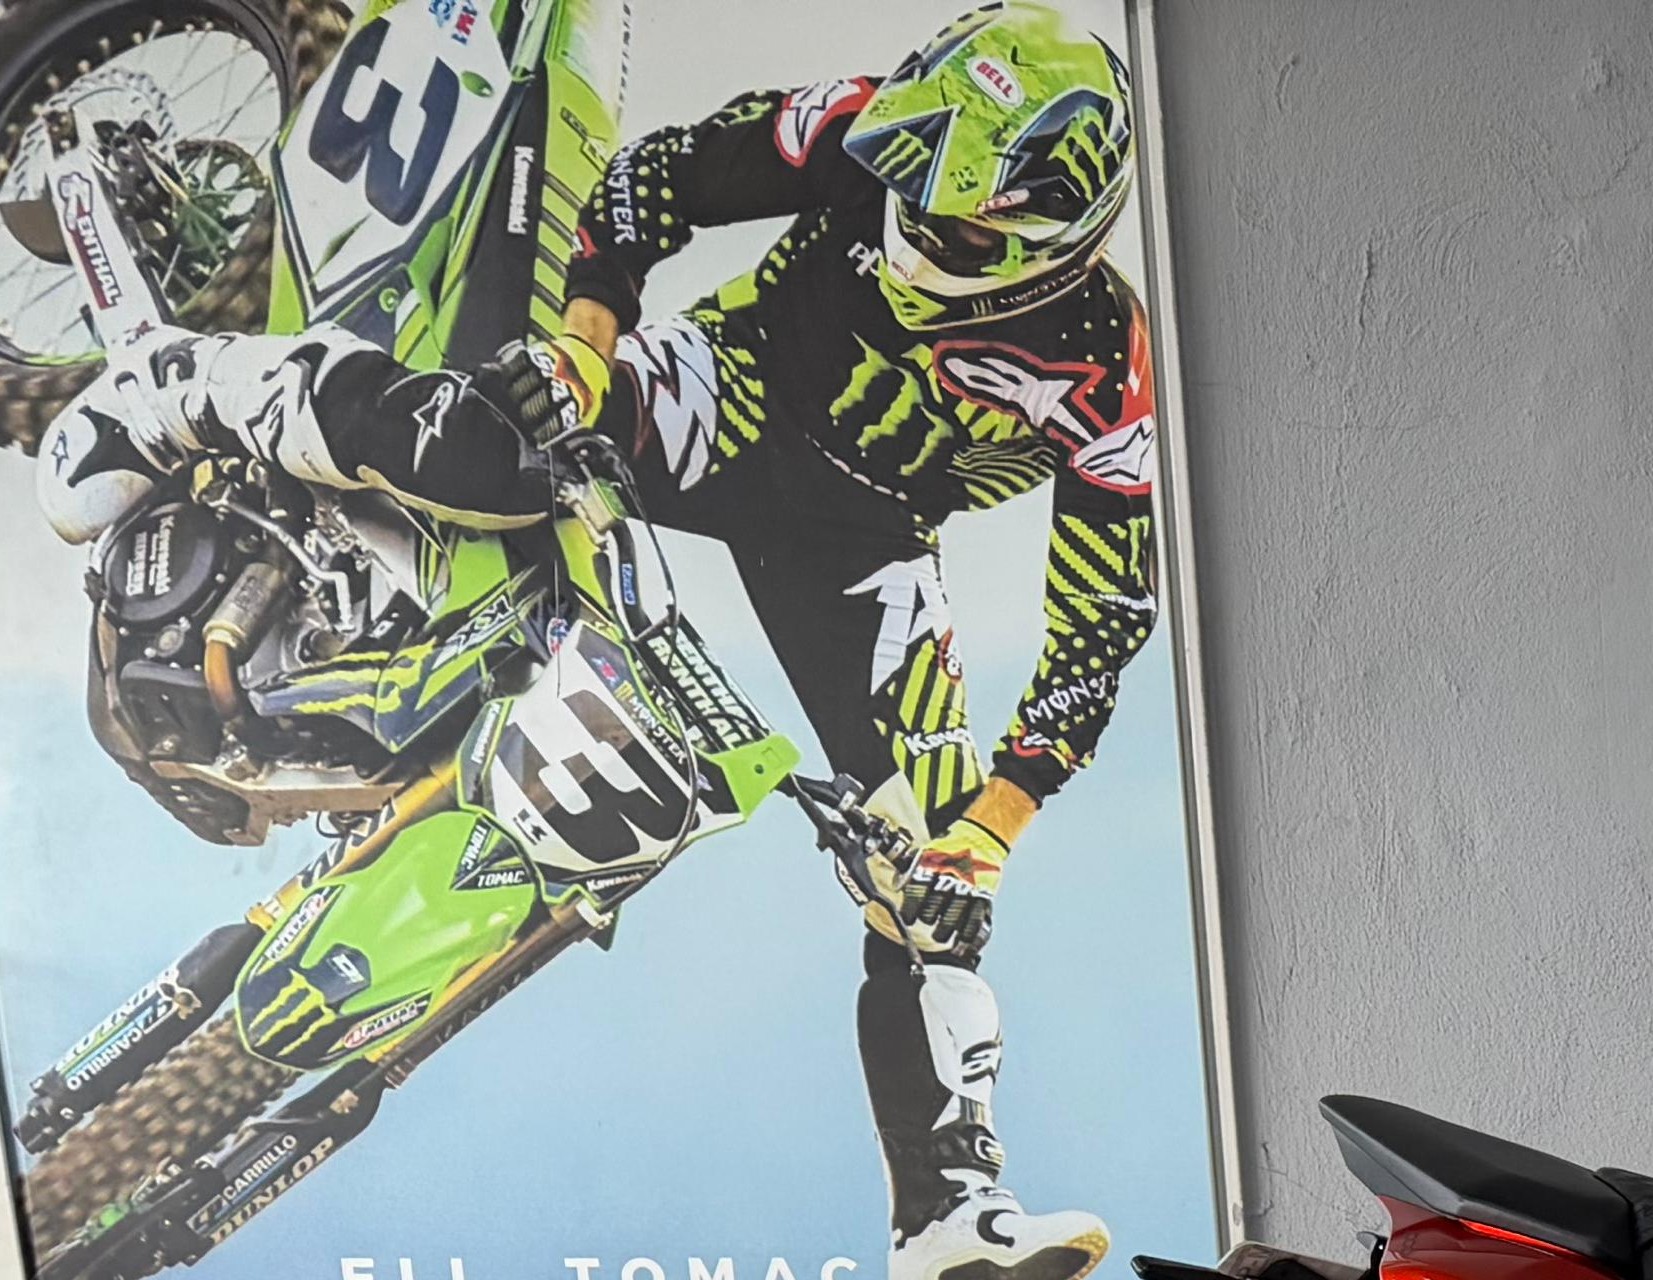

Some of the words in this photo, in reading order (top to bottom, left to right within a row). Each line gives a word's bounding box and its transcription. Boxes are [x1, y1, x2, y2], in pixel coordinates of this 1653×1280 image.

[974, 61, 1013, 99] BELL
[477, 868, 526, 888] TOMAC
[66, 1026, 143, 1091] CARRILLO
[209, 1135, 334, 1244] DUNLOP
[222, 1133, 298, 1201] CARRILLO
